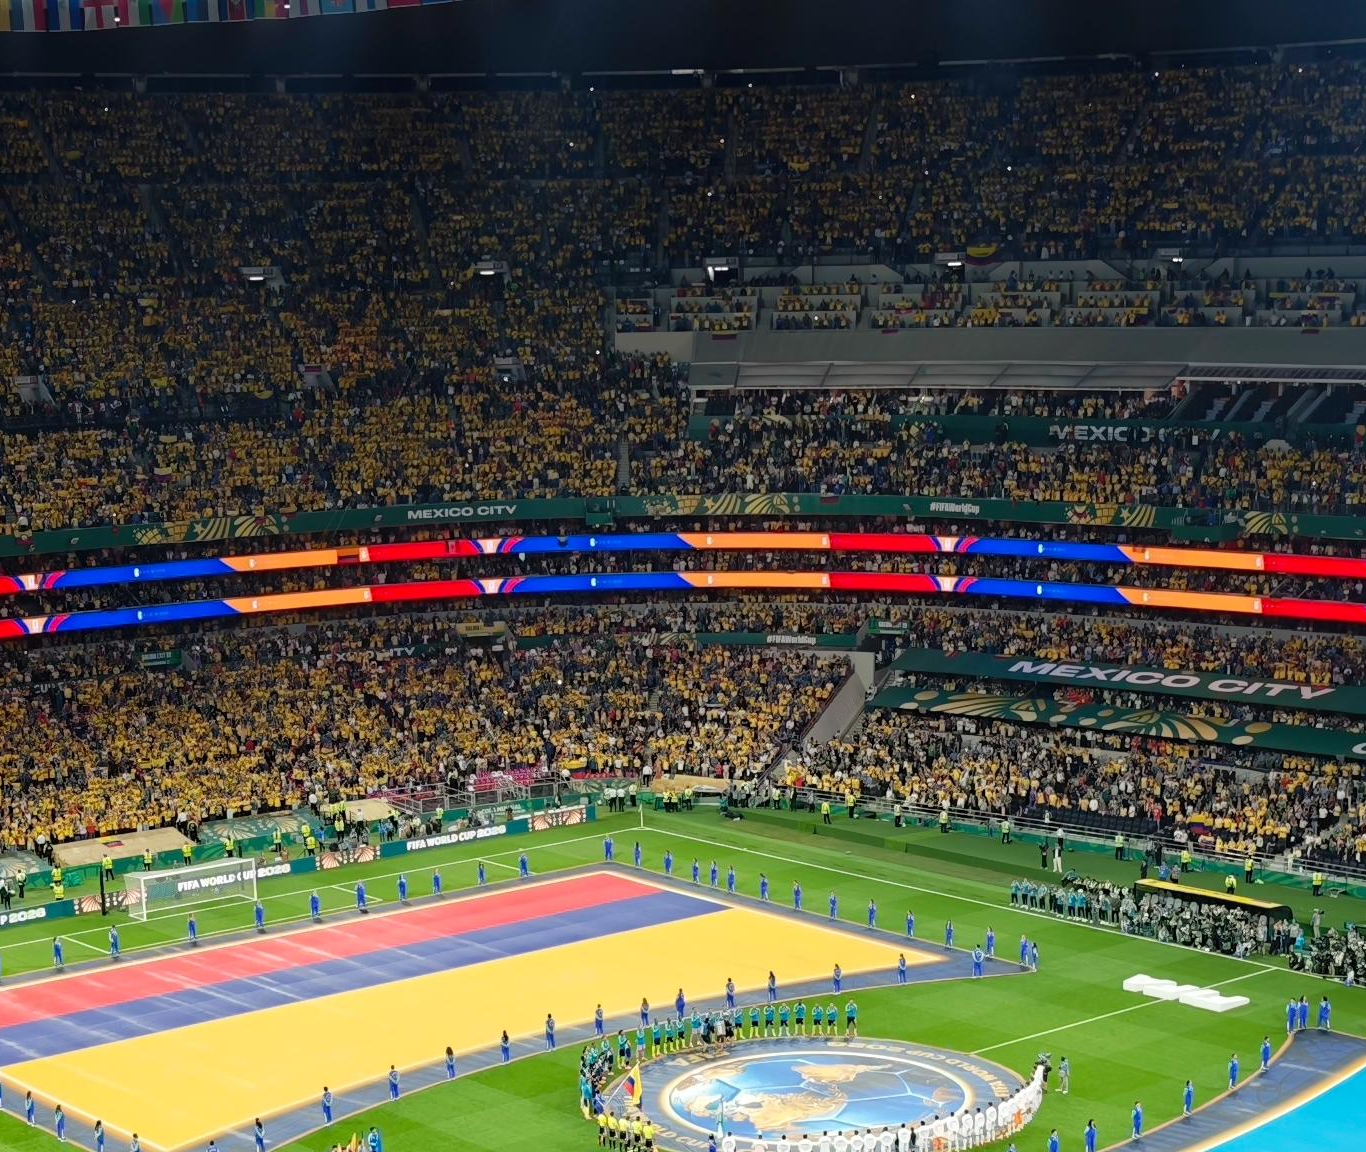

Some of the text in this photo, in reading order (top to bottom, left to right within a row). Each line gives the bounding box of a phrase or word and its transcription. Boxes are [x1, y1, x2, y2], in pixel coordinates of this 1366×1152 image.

[408, 505, 517, 520] MEXICO CITY
[1008, 661, 1336, 699] MEXICO CITY
[407, 825, 506, 851] FIFA WORLD CUP 2026
[178, 864, 291, 892] FIFA WORLD CUP 2026
[9, 907, 46, 923] 2026
